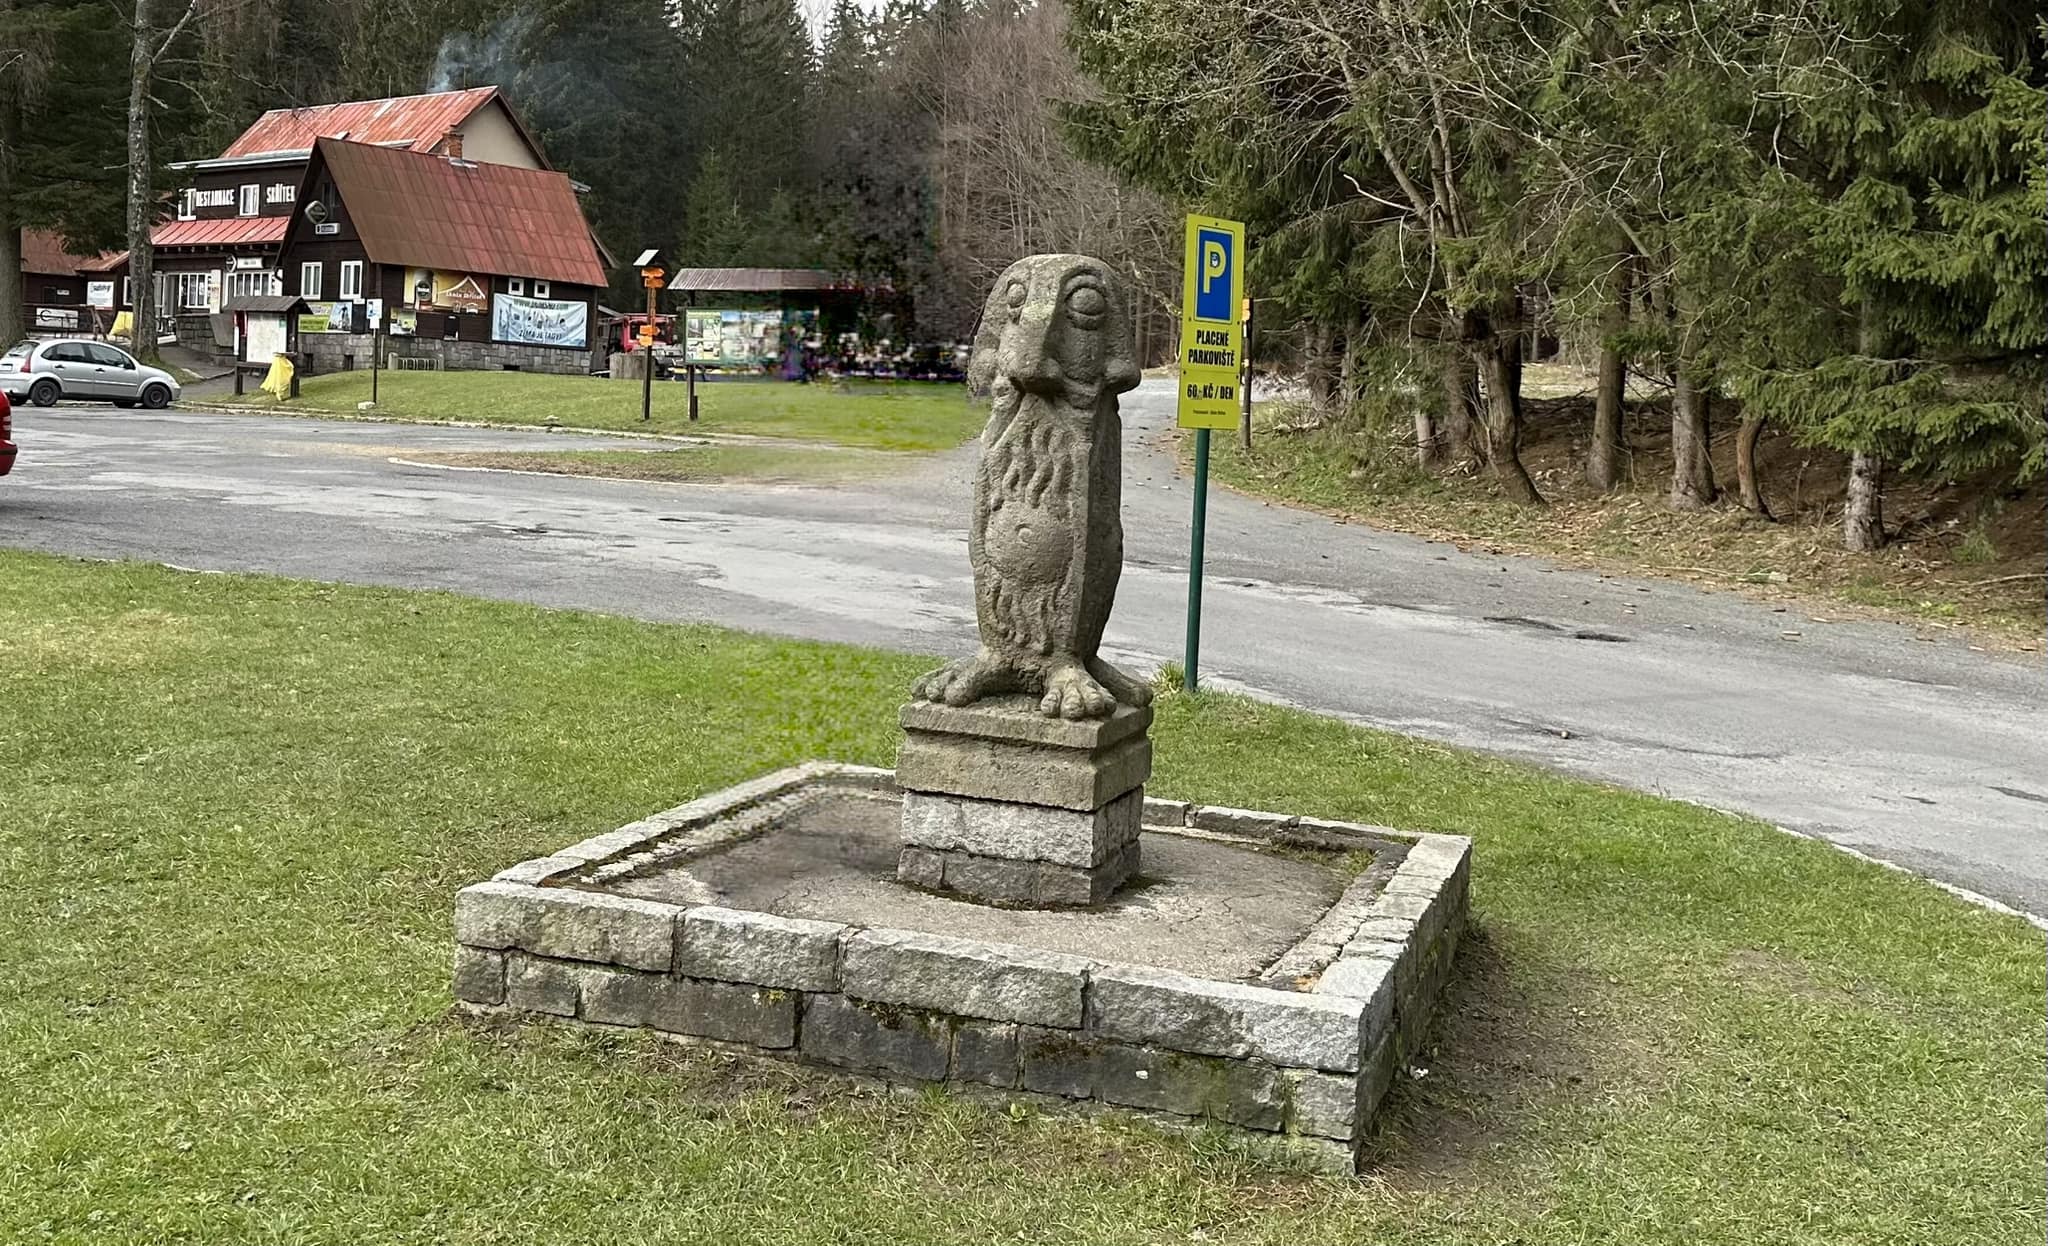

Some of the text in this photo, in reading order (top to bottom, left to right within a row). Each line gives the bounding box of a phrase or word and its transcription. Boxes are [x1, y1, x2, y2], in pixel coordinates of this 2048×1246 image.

[1203, 240, 1227, 294] P
[1196, 329, 1230, 347] PLACENÉ
[1188, 348, 1235, 367] PARKOVIŠTĚ
[1220, 386, 1234, 400] DEN
